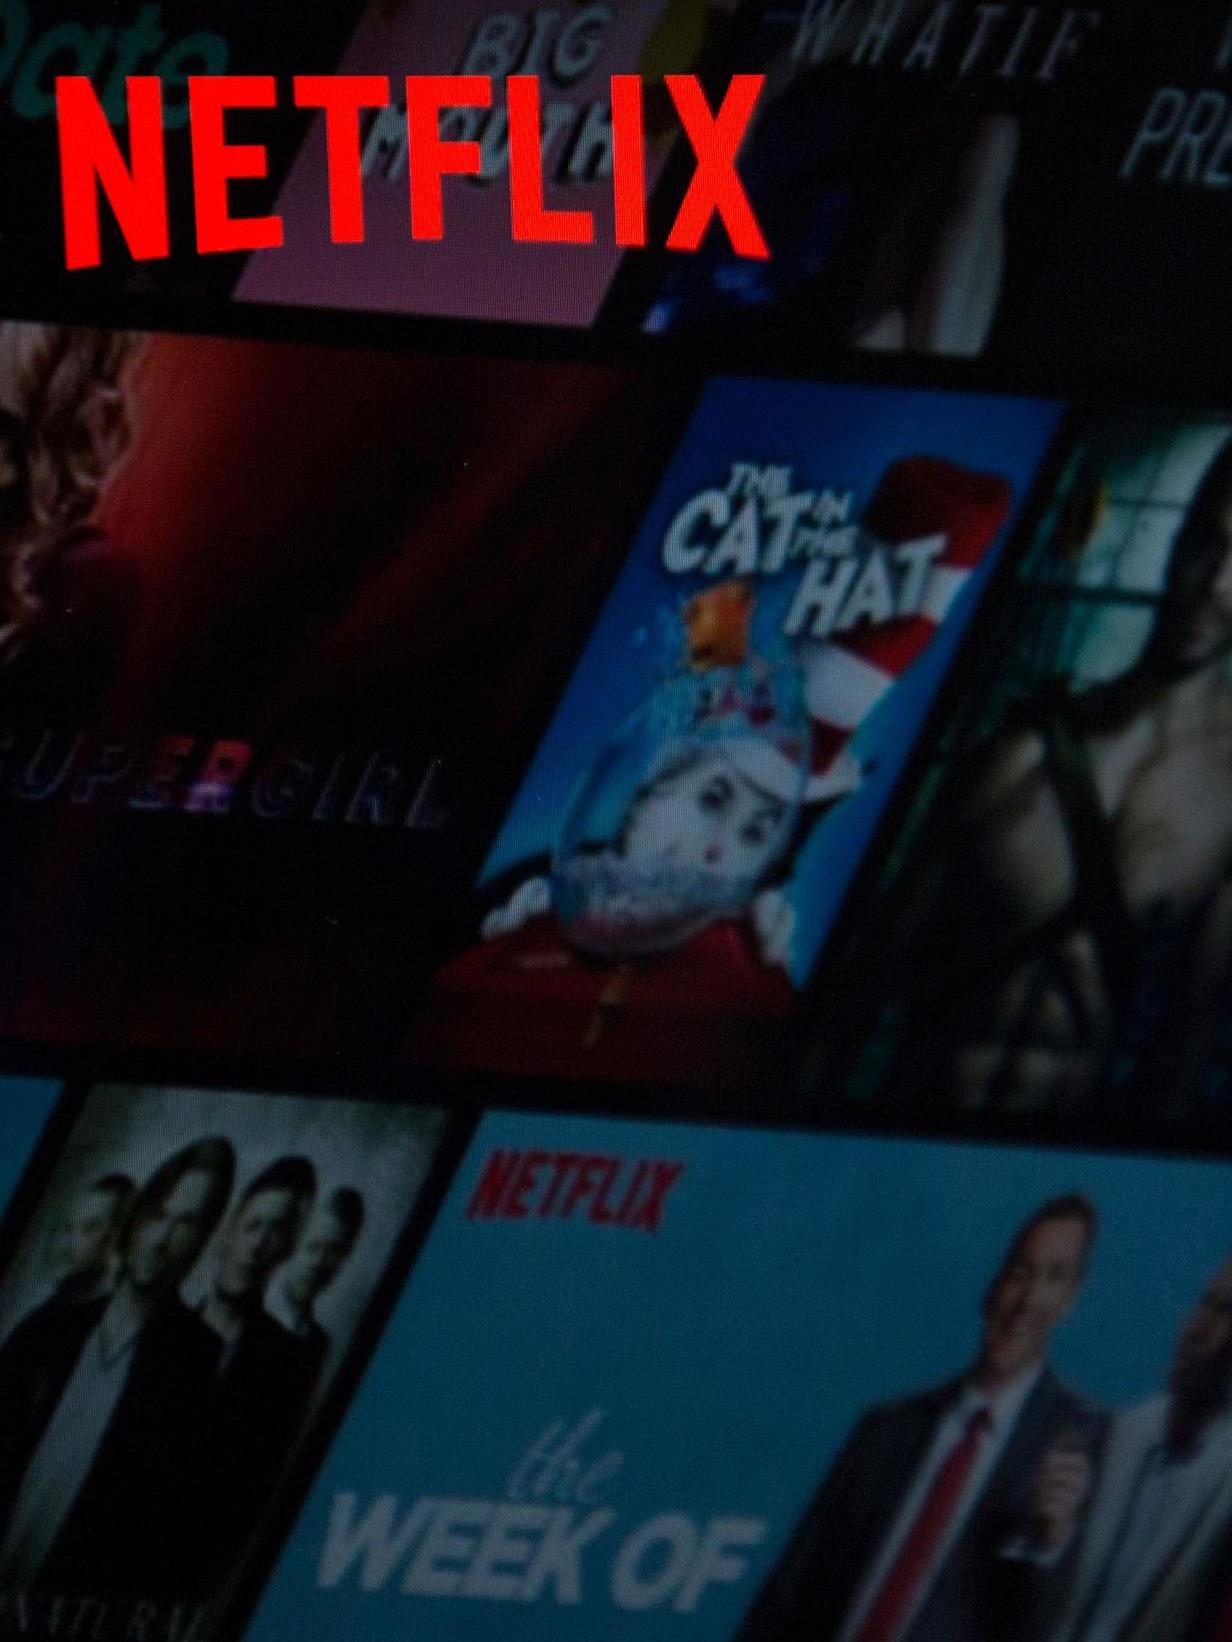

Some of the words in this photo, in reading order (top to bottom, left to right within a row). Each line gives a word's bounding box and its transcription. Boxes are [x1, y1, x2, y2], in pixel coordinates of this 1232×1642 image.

[462, 3, 609, 81] BIG
[56, 74, 770, 271] NETFLIX
[661, 486, 814, 576] CAT
[783, 532, 949, 638] HAT
[0, 728, 452, 832] UPERGIRL
[465, 1148, 686, 1235] NETFLIX
[508, 1408, 624, 1500] the
[316, 1490, 615, 1606] WEEK
[608, 1510, 768, 1613] OF
